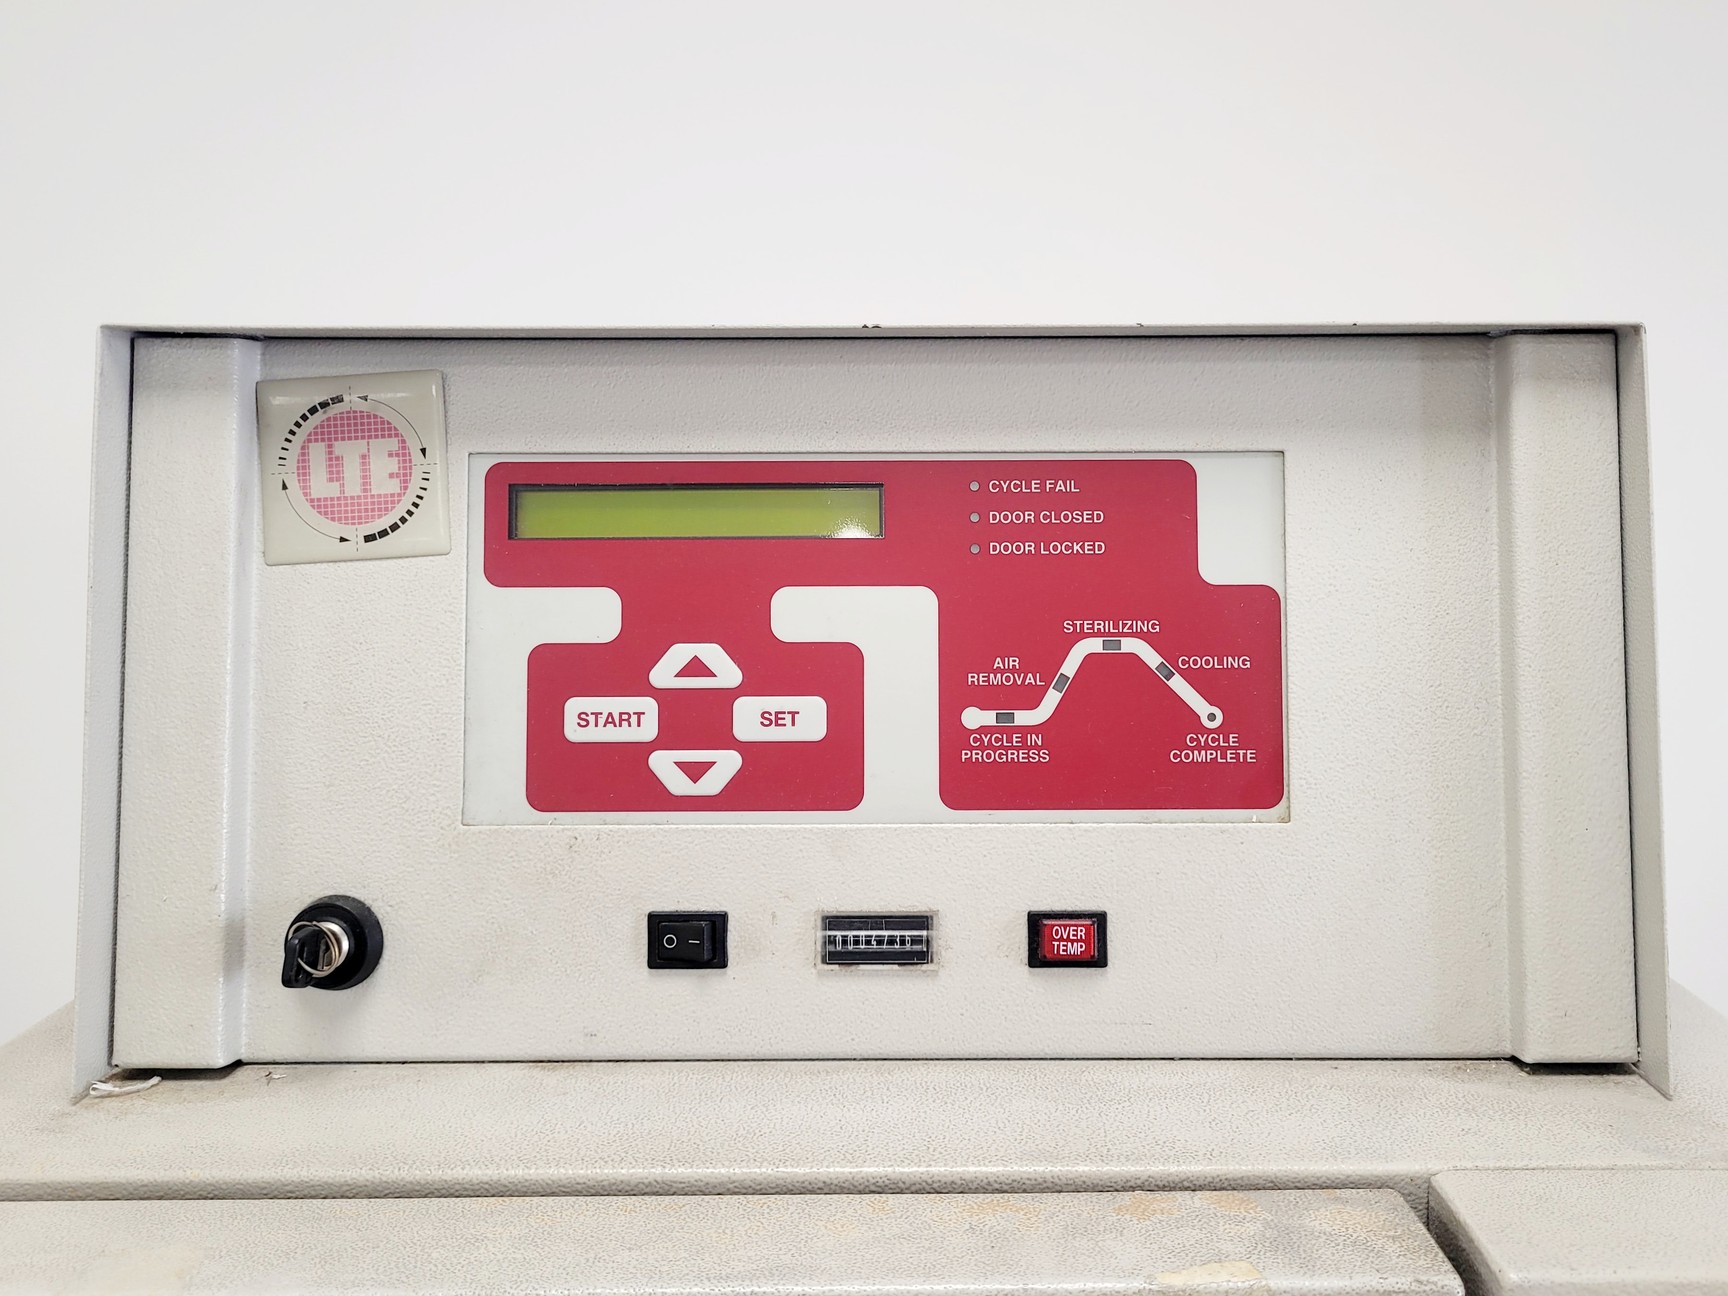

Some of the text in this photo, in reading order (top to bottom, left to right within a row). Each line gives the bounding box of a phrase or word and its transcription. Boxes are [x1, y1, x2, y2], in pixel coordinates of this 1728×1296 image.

[308, 438, 401, 499] LTE
[988, 480, 1080, 493] CYCLE FAIL
[989, 511, 1104, 524] DOOR CLOSED
[989, 541, 1106, 555] DOOR LOCKED
[1063, 620, 1160, 633] STERILIZING
[993, 657, 1020, 670] AIR
[1178, 656, 1251, 669] COOLING
[967, 672, 1046, 686] REMOVAL
[576, 711, 646, 729] START
[759, 710, 800, 728] SET
[969, 733, 1042, 747] CYCLE IN
[1186, 733, 1240, 747] CYCLE
[961, 750, 1050, 763] PROGRESS
[1169, 750, 1257, 763] COMPLETE
[1052, 926, 1086, 940] OVER
[1052, 942, 1086, 956] TEMP
